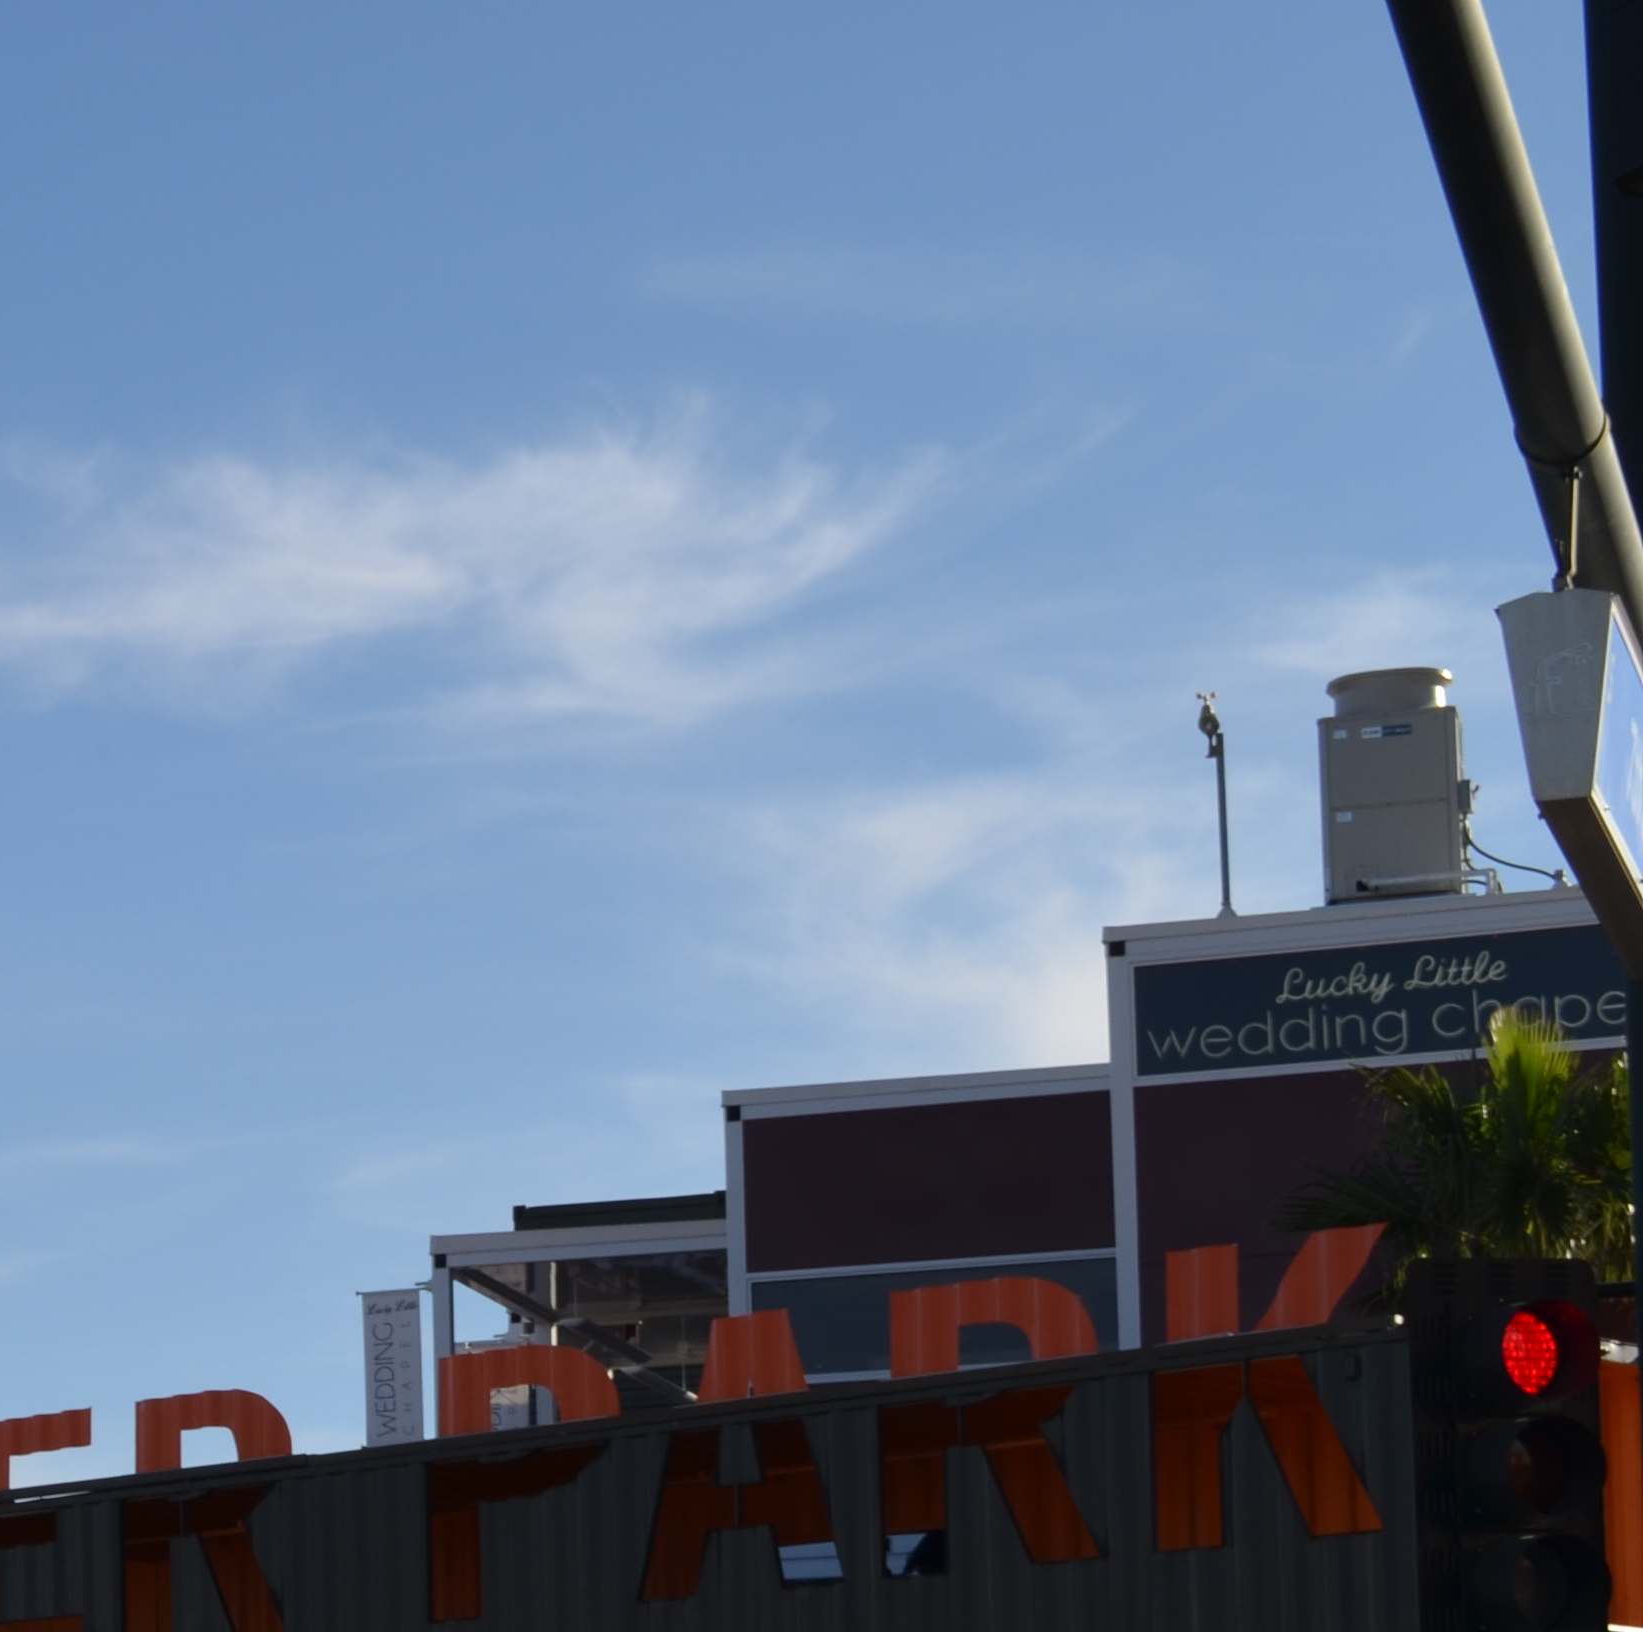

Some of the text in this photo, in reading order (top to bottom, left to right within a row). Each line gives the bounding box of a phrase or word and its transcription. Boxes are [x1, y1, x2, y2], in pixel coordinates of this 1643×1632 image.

[1146, 988, 1627, 1059] wedding chape
[1275, 950, 1508, 1005] Lucky Little
[371, 1321, 398, 1438] WEDDING
[399, 1320, 415, 1436] CHAPEL
[426, 1222, 1390, 1624] PARK
